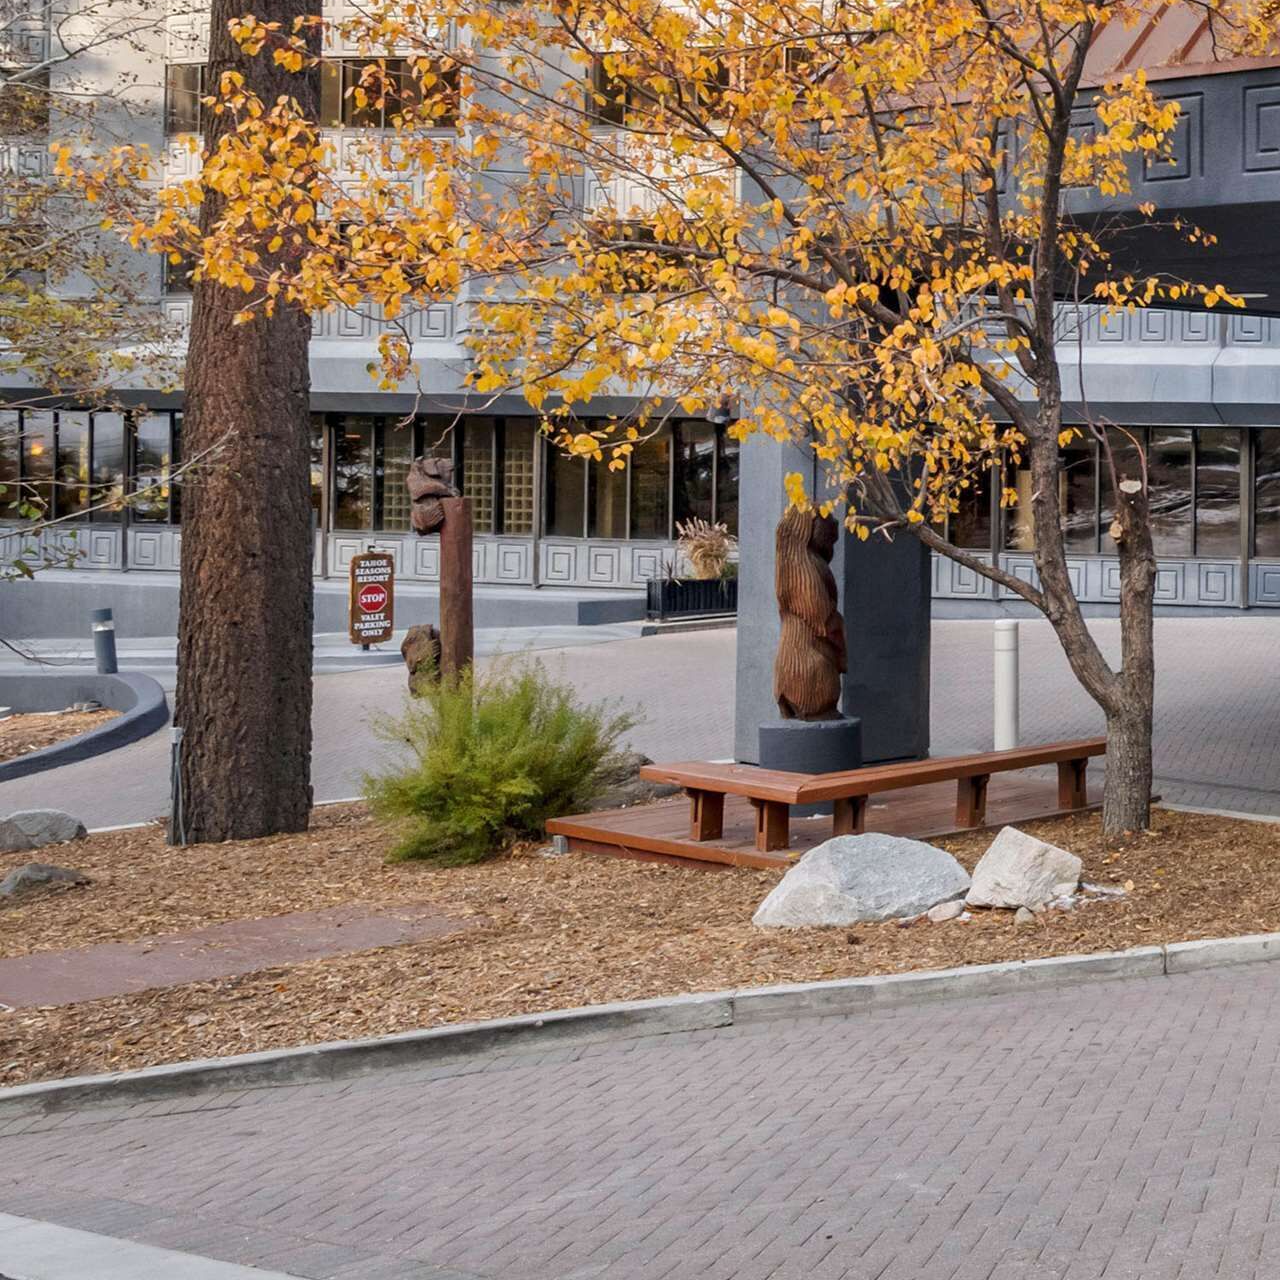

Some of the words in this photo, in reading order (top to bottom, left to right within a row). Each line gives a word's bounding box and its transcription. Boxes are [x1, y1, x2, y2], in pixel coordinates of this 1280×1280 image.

[361, 594, 385, 602] STOP
[361, 613, 385, 621] VALET
[354, 621, 391, 630] PARKING
[361, 629, 384, 637] ONLY
